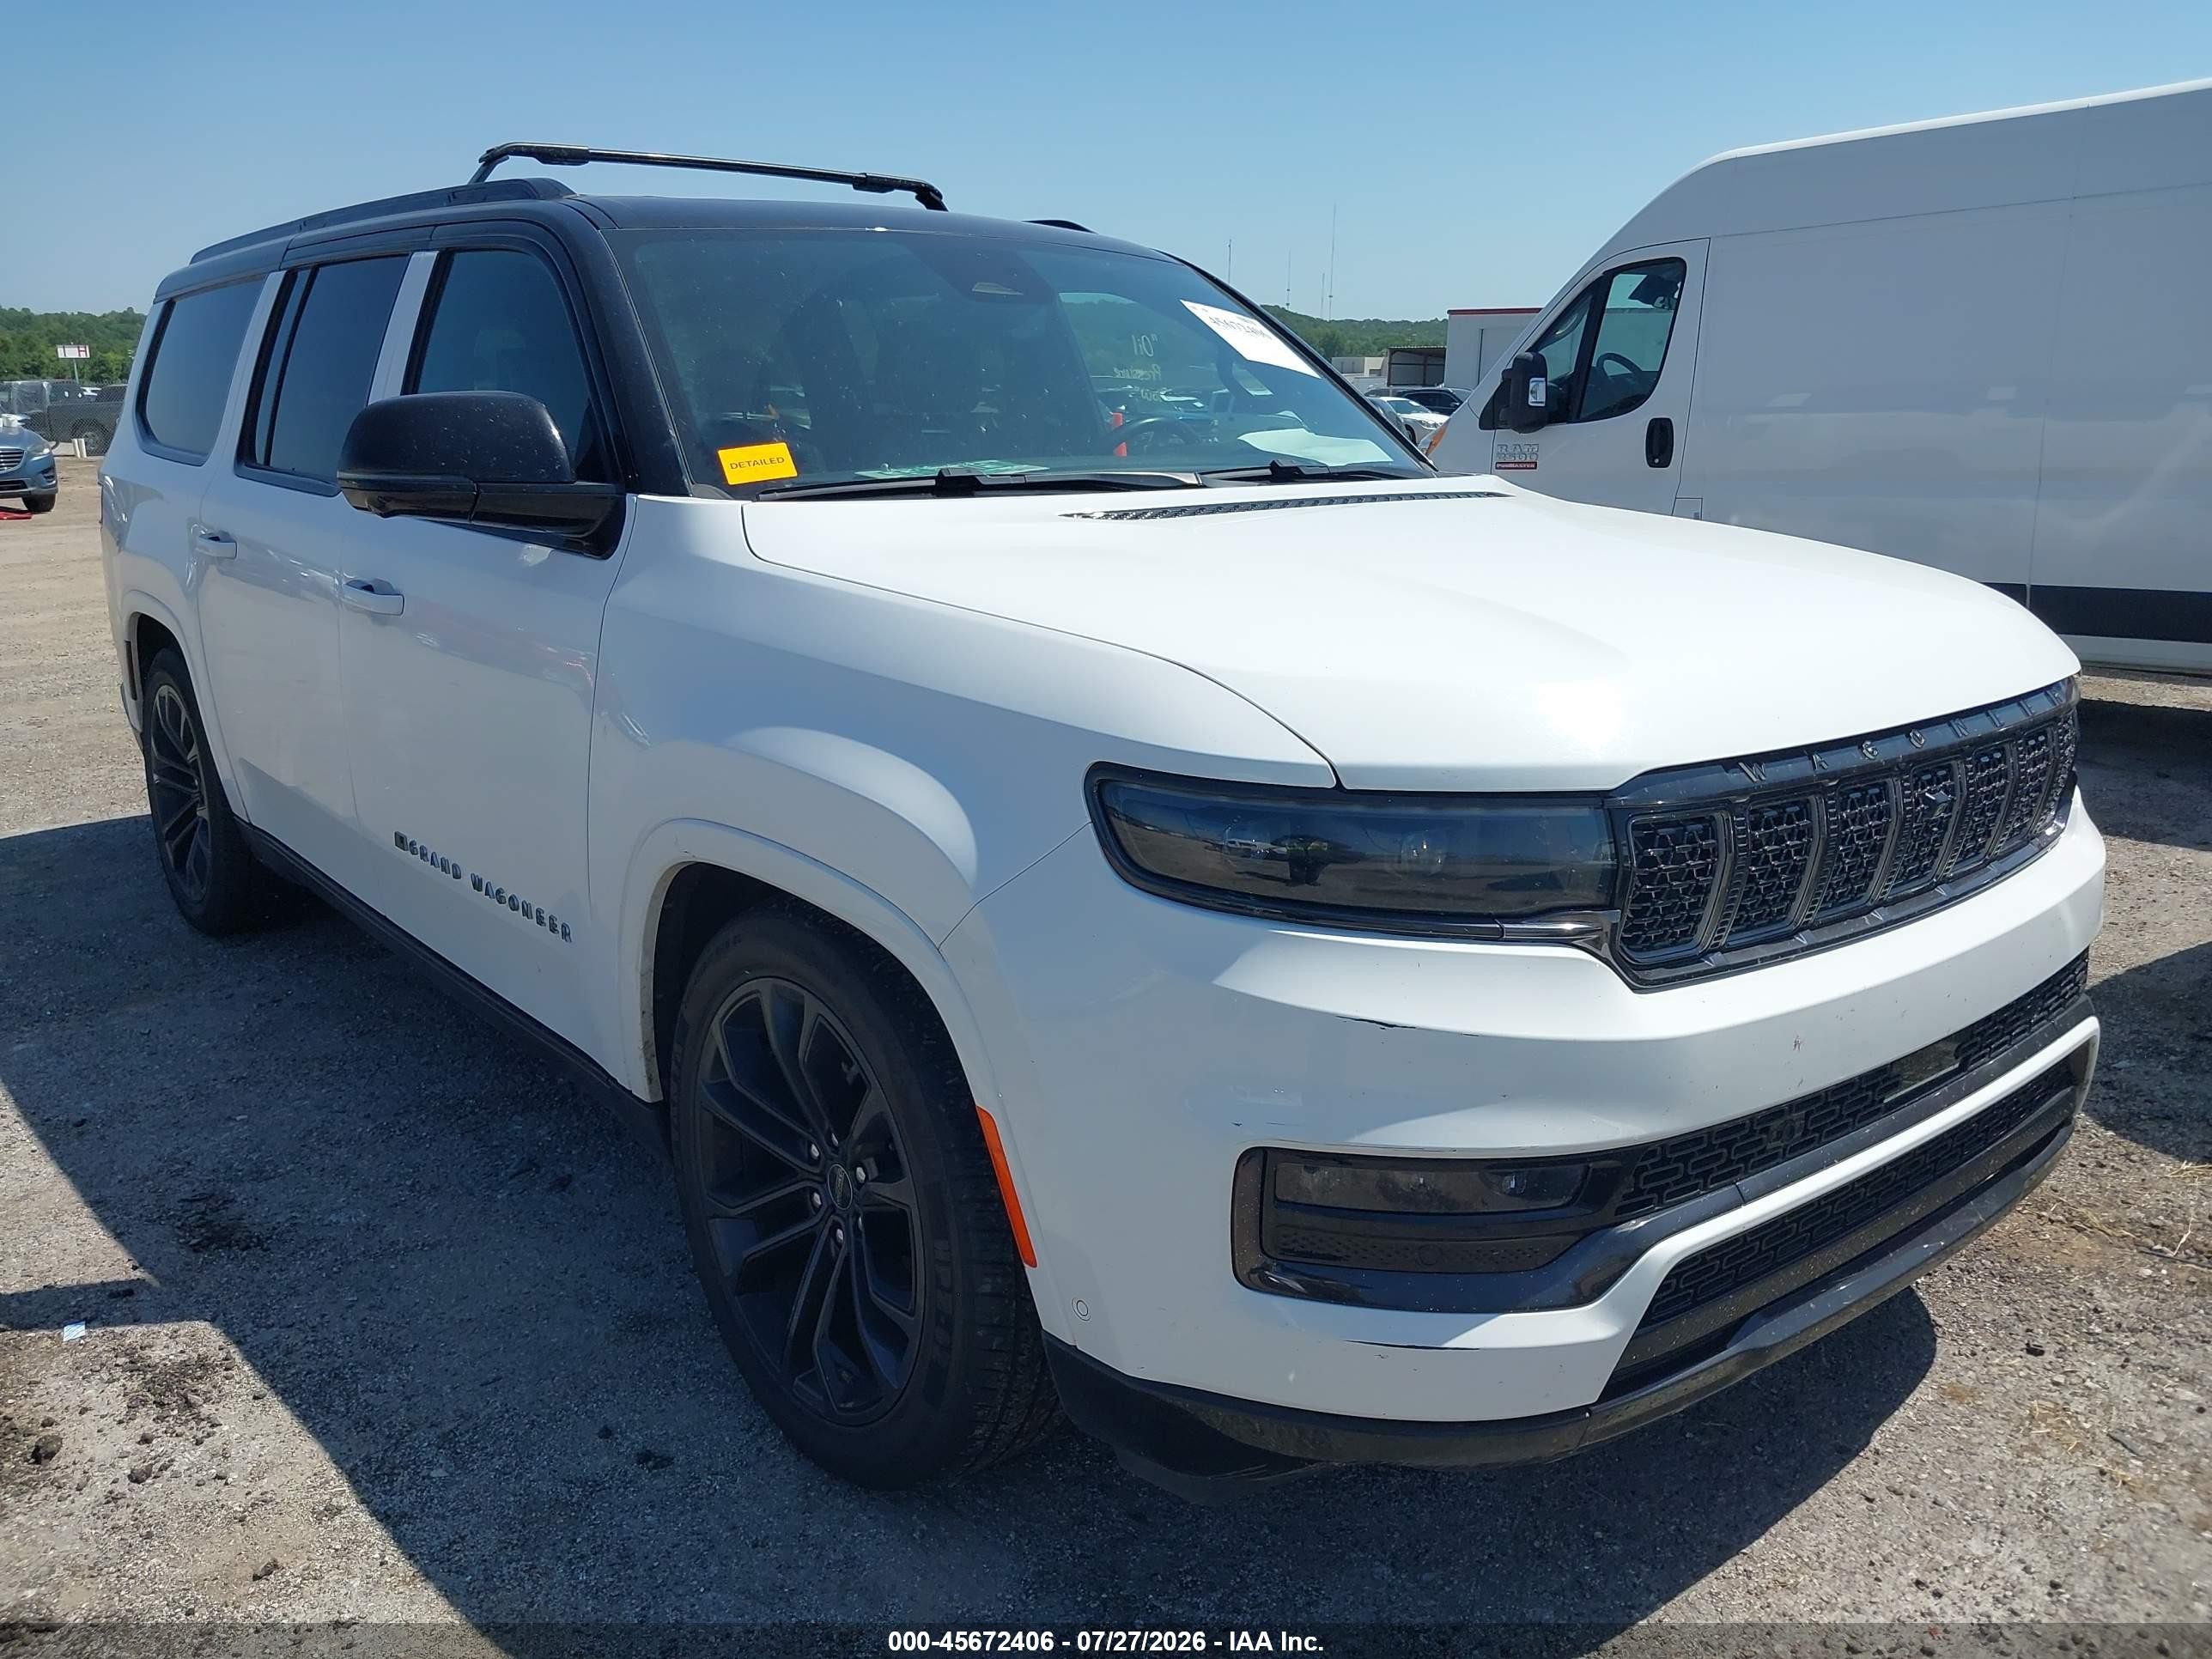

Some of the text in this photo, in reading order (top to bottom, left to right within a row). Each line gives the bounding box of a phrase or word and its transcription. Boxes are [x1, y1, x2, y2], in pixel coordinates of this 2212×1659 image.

[729, 457, 785, 470] DETAILED
[1497, 444, 1539, 453] RAM
[1737, 680, 2064, 783] WAGONEER
[409, 840, 573, 943] GRAND WAGONEER
